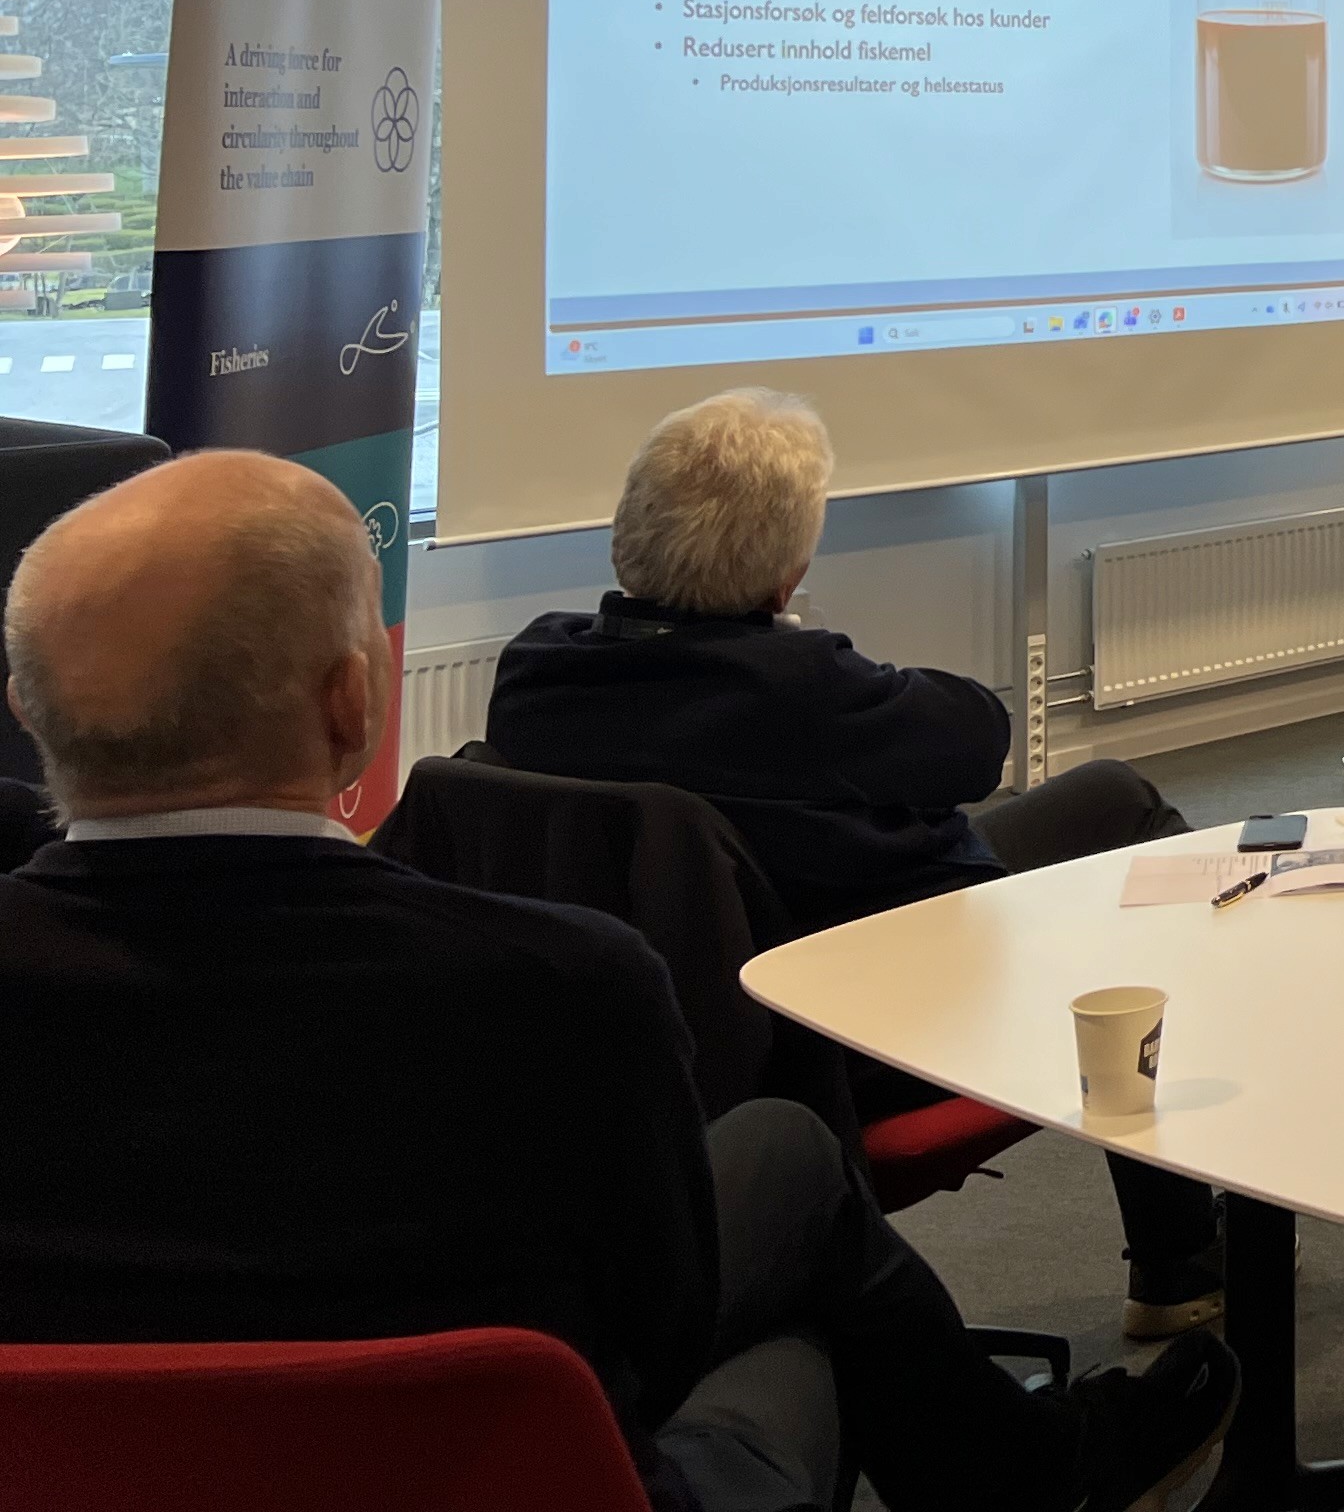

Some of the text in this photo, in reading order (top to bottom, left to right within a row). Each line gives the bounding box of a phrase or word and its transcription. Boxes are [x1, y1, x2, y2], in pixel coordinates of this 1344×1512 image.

[831, 8, 856, 29] og
[861, 3, 949, 26] feltforsøk
[953, 7, 984, 27] hos
[990, 8, 1051, 29] kunder
[225, 43, 342, 75] A driving force for
[683, 36, 932, 62] Redusert innhold fiskemel
[224, 83, 321, 110] interaction and
[720, 74, 1005, 98] Produksjonsresultater og helsestatus
[222, 124, 359, 154] circularity throughout
[220, 163, 314, 190] the value chain
[210, 344, 269, 376] Fisheries
